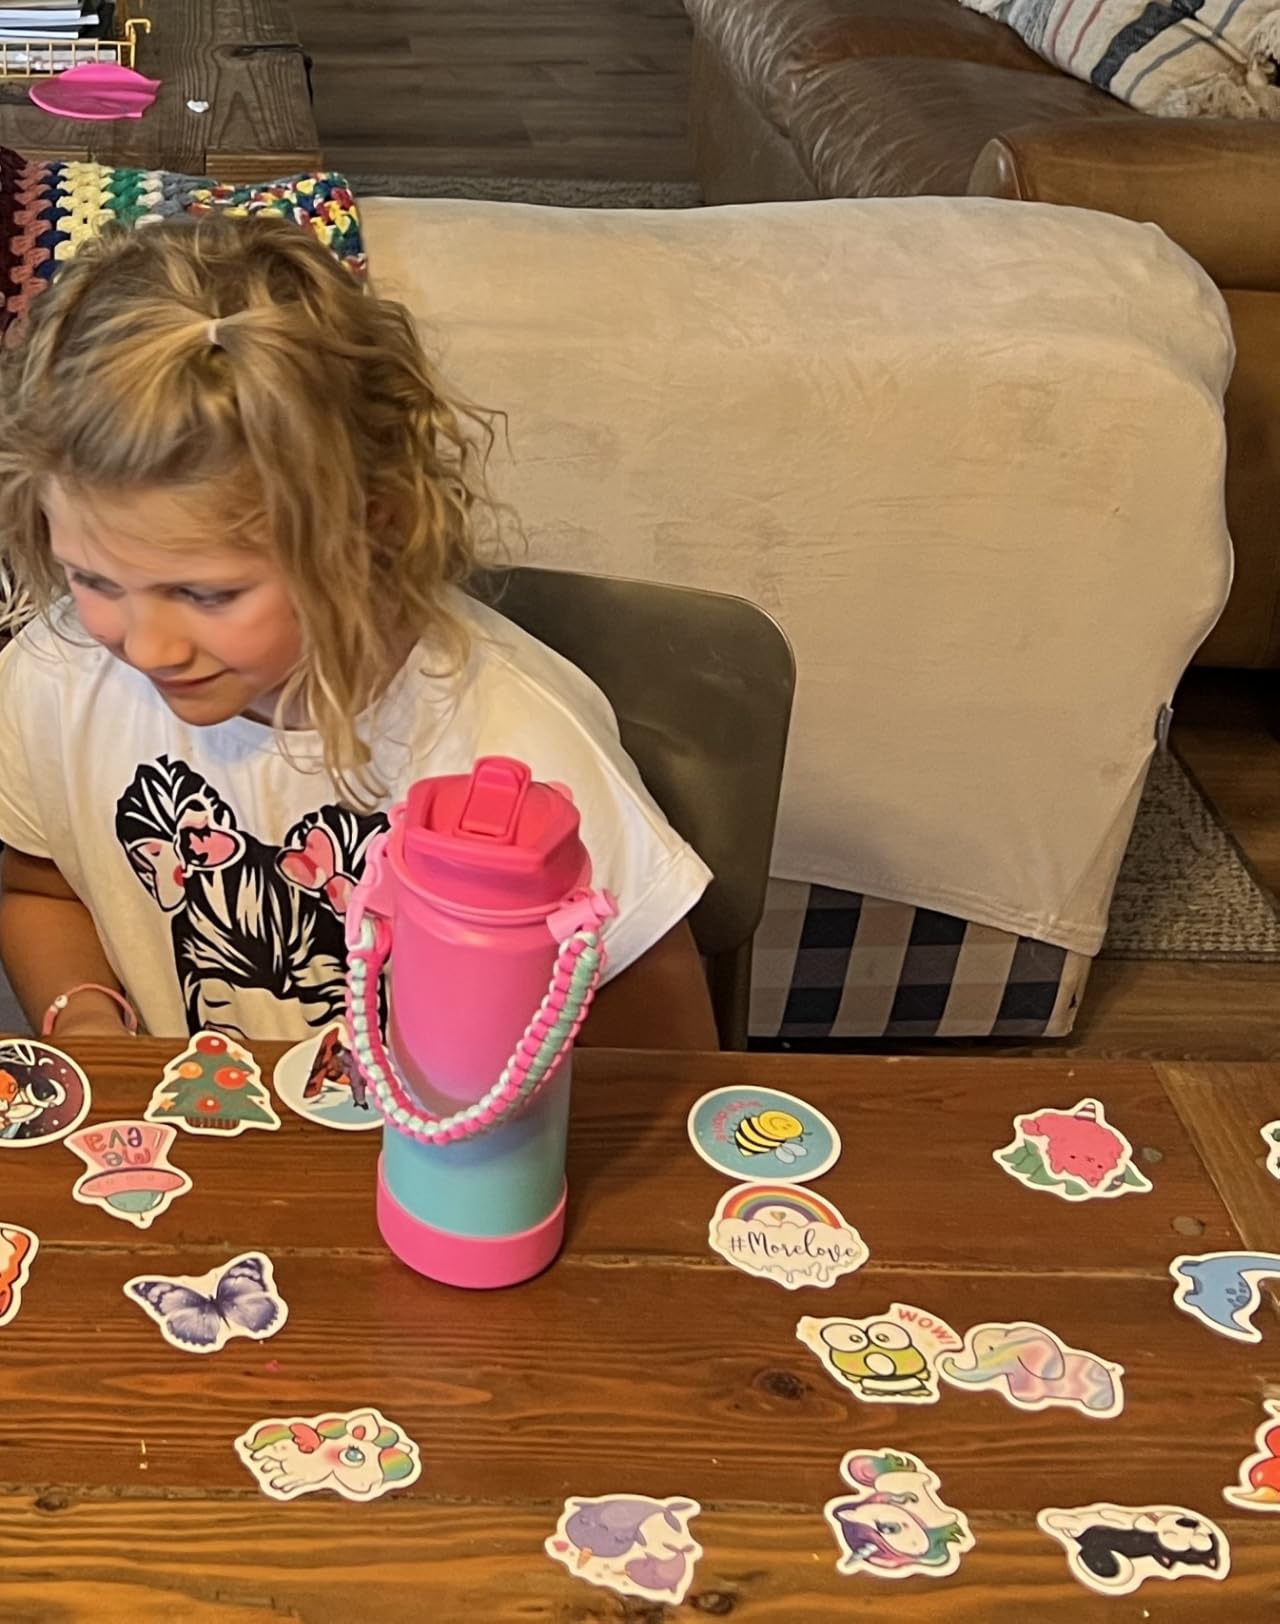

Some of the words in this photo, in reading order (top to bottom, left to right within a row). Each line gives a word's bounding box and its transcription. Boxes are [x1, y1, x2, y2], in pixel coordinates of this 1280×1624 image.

[102, 1147, 151, 1167] me
[730, 1228, 856, 1262] #Morelove
[898, 1308, 956, 1344] WOW!
